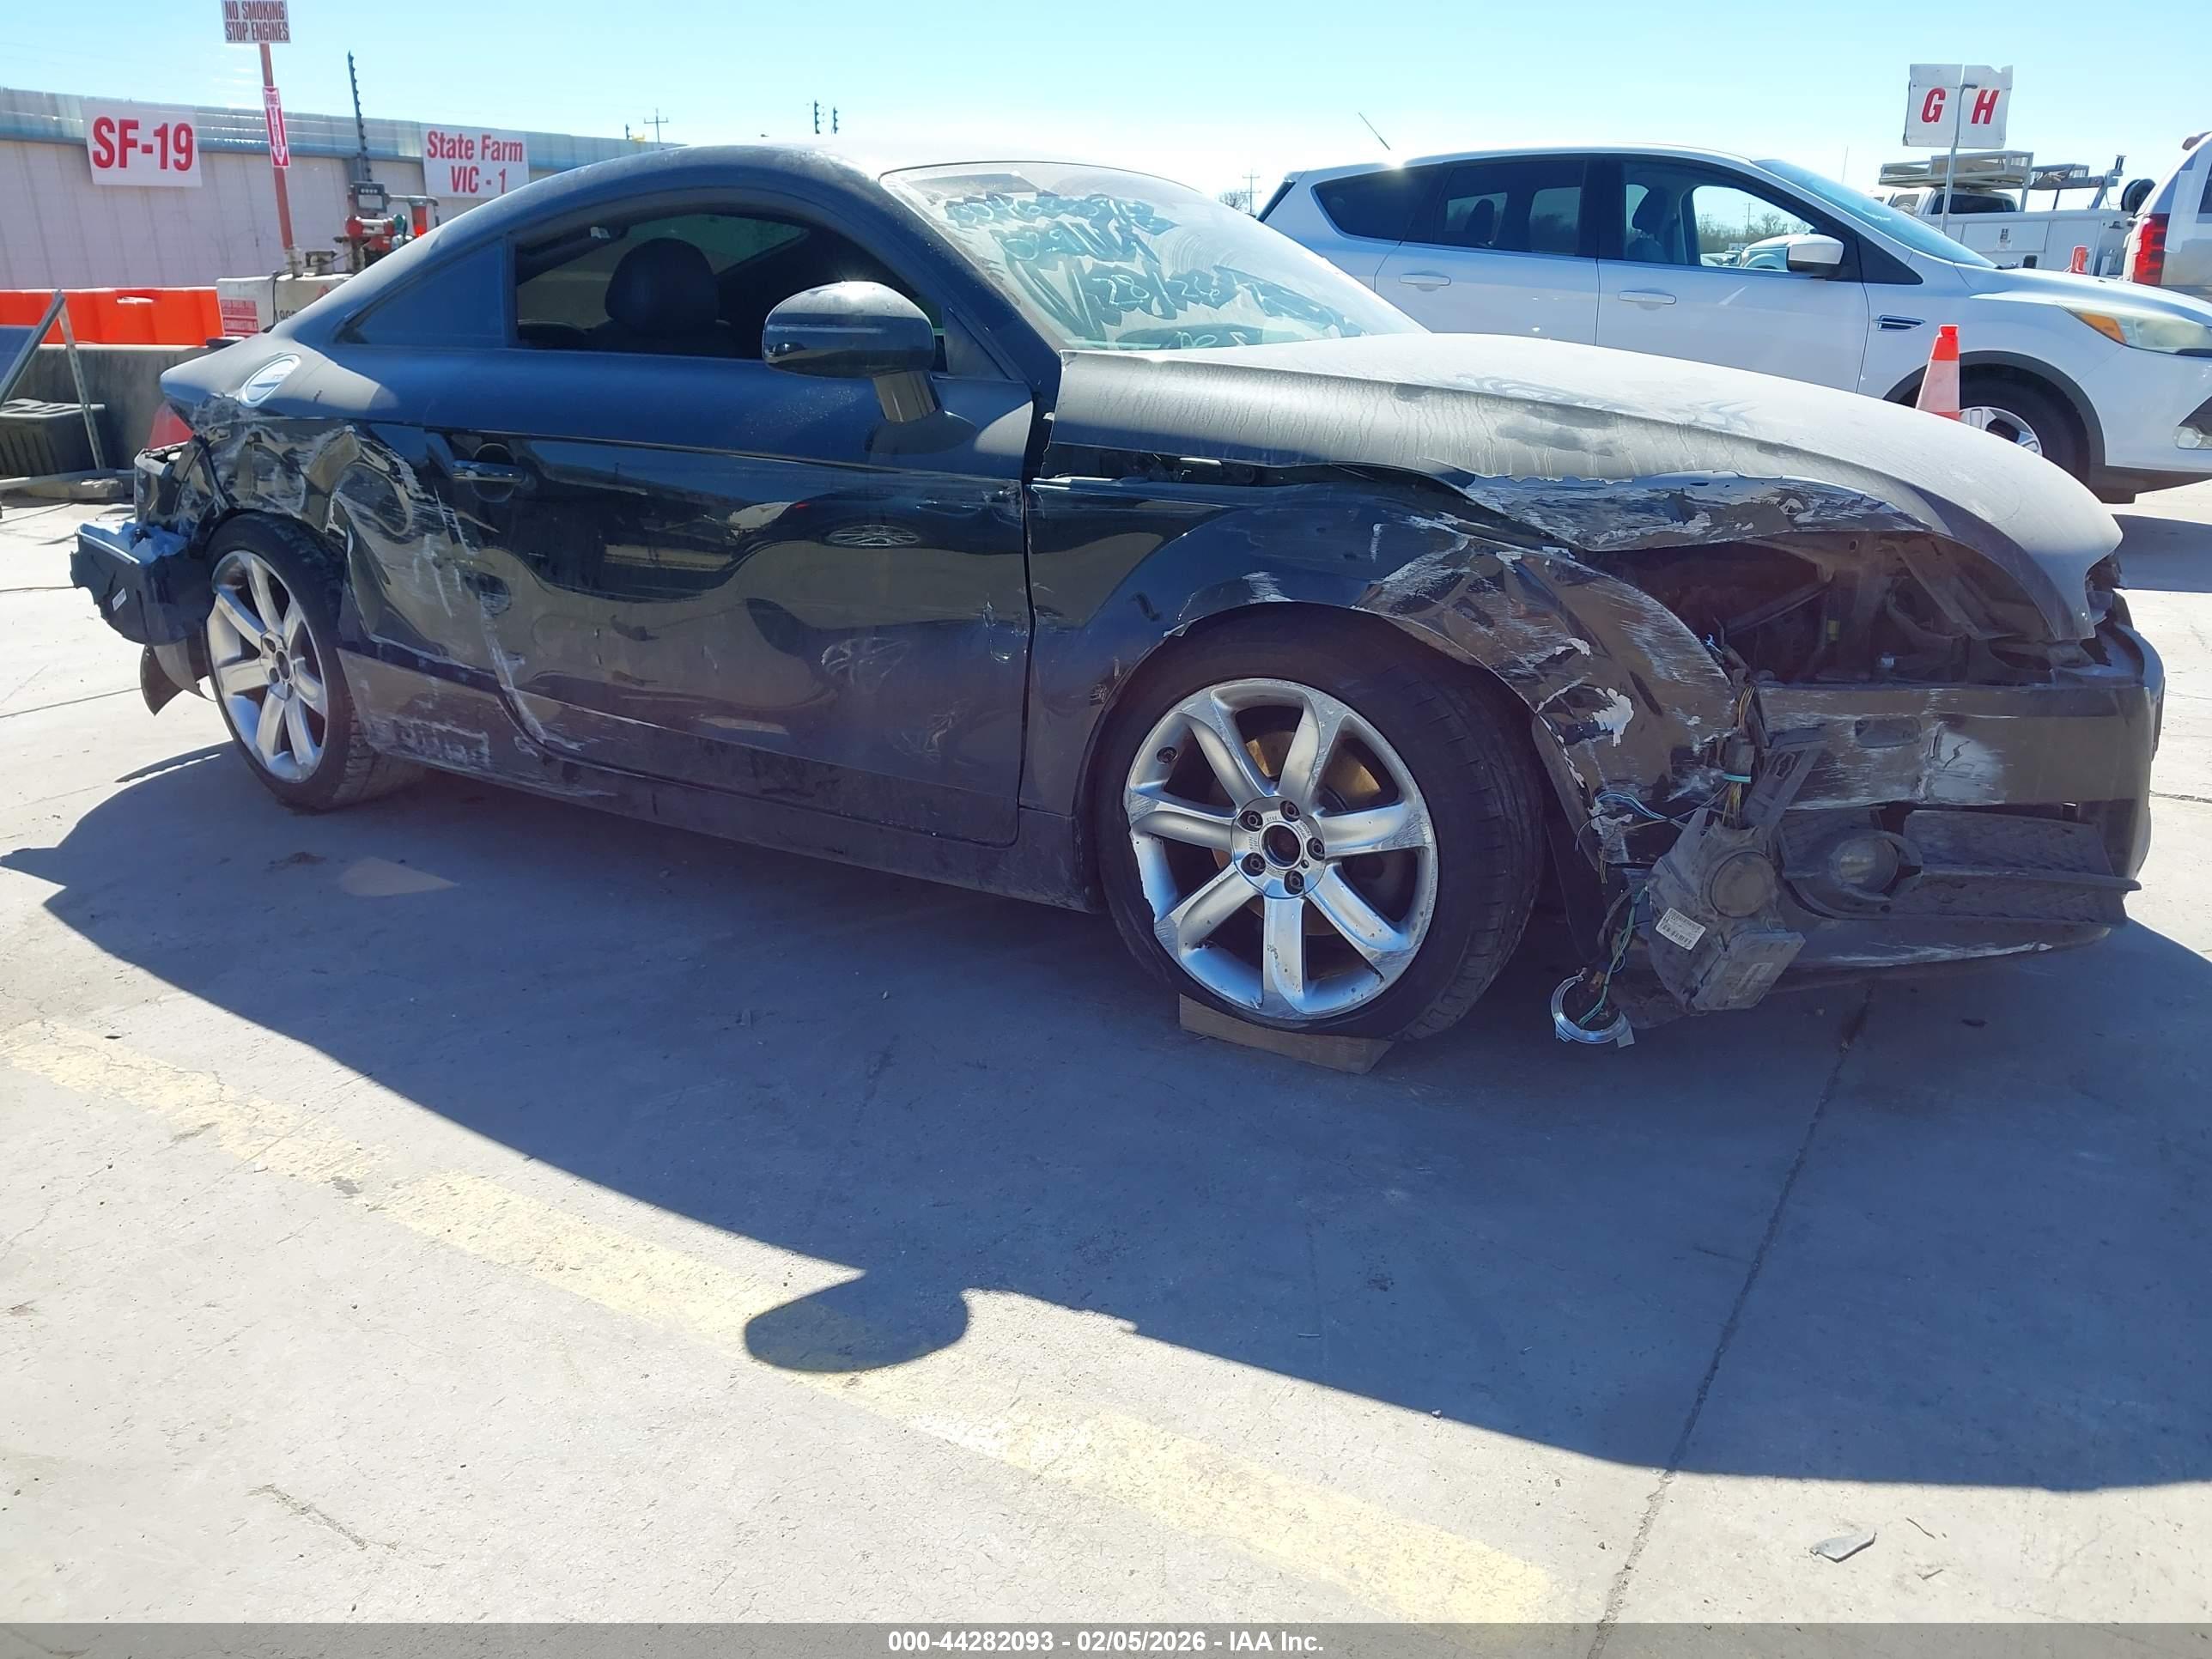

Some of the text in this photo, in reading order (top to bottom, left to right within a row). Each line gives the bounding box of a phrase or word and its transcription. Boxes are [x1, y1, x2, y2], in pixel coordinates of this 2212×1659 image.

[225, 1, 285, 21] NO SMOKING
[225, 21, 289, 41] STOP ENGINES
[1922, 88, 1947, 123] G
[1971, 89, 2000, 125] H
[92, 117, 193, 172] SF-19
[427, 131, 523, 161] State Farm
[451, 165, 479, 193] VIC
[498, 168, 507, 194] 1
